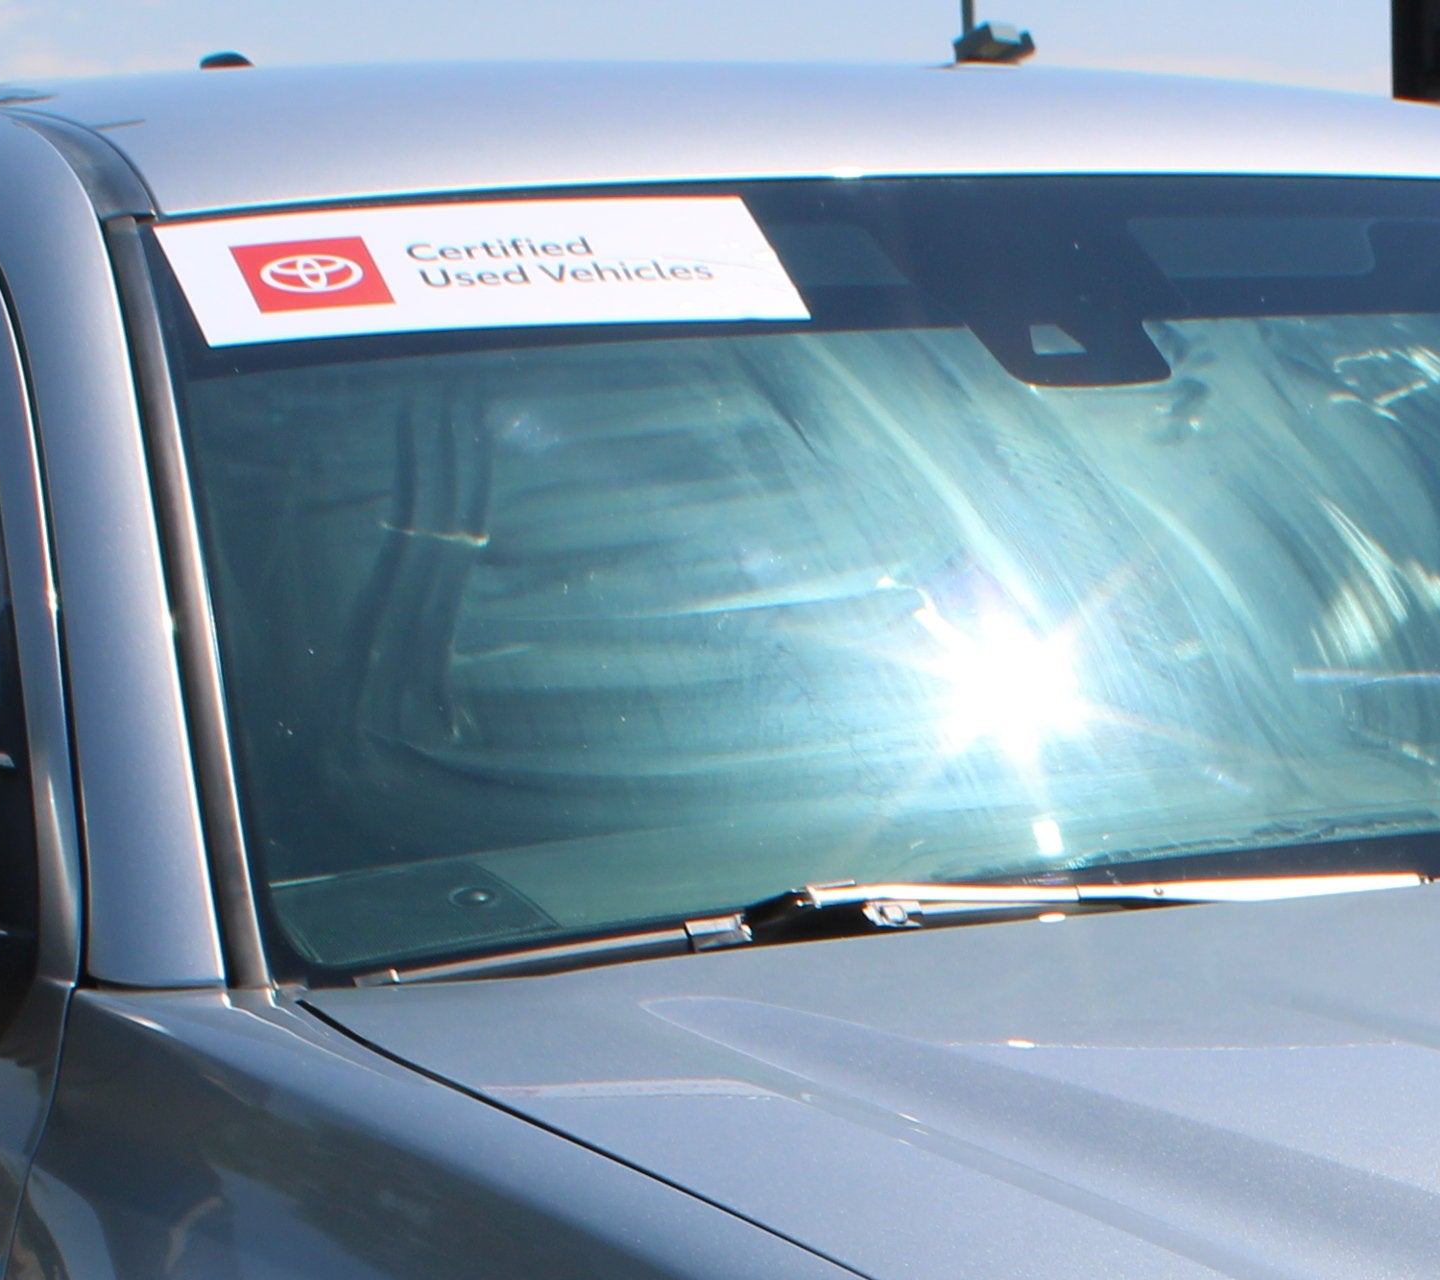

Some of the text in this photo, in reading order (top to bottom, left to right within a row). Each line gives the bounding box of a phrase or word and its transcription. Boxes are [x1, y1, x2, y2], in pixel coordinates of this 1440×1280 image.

[406, 236, 595, 262] Certified
[419, 260, 715, 288] Used Vehicles
